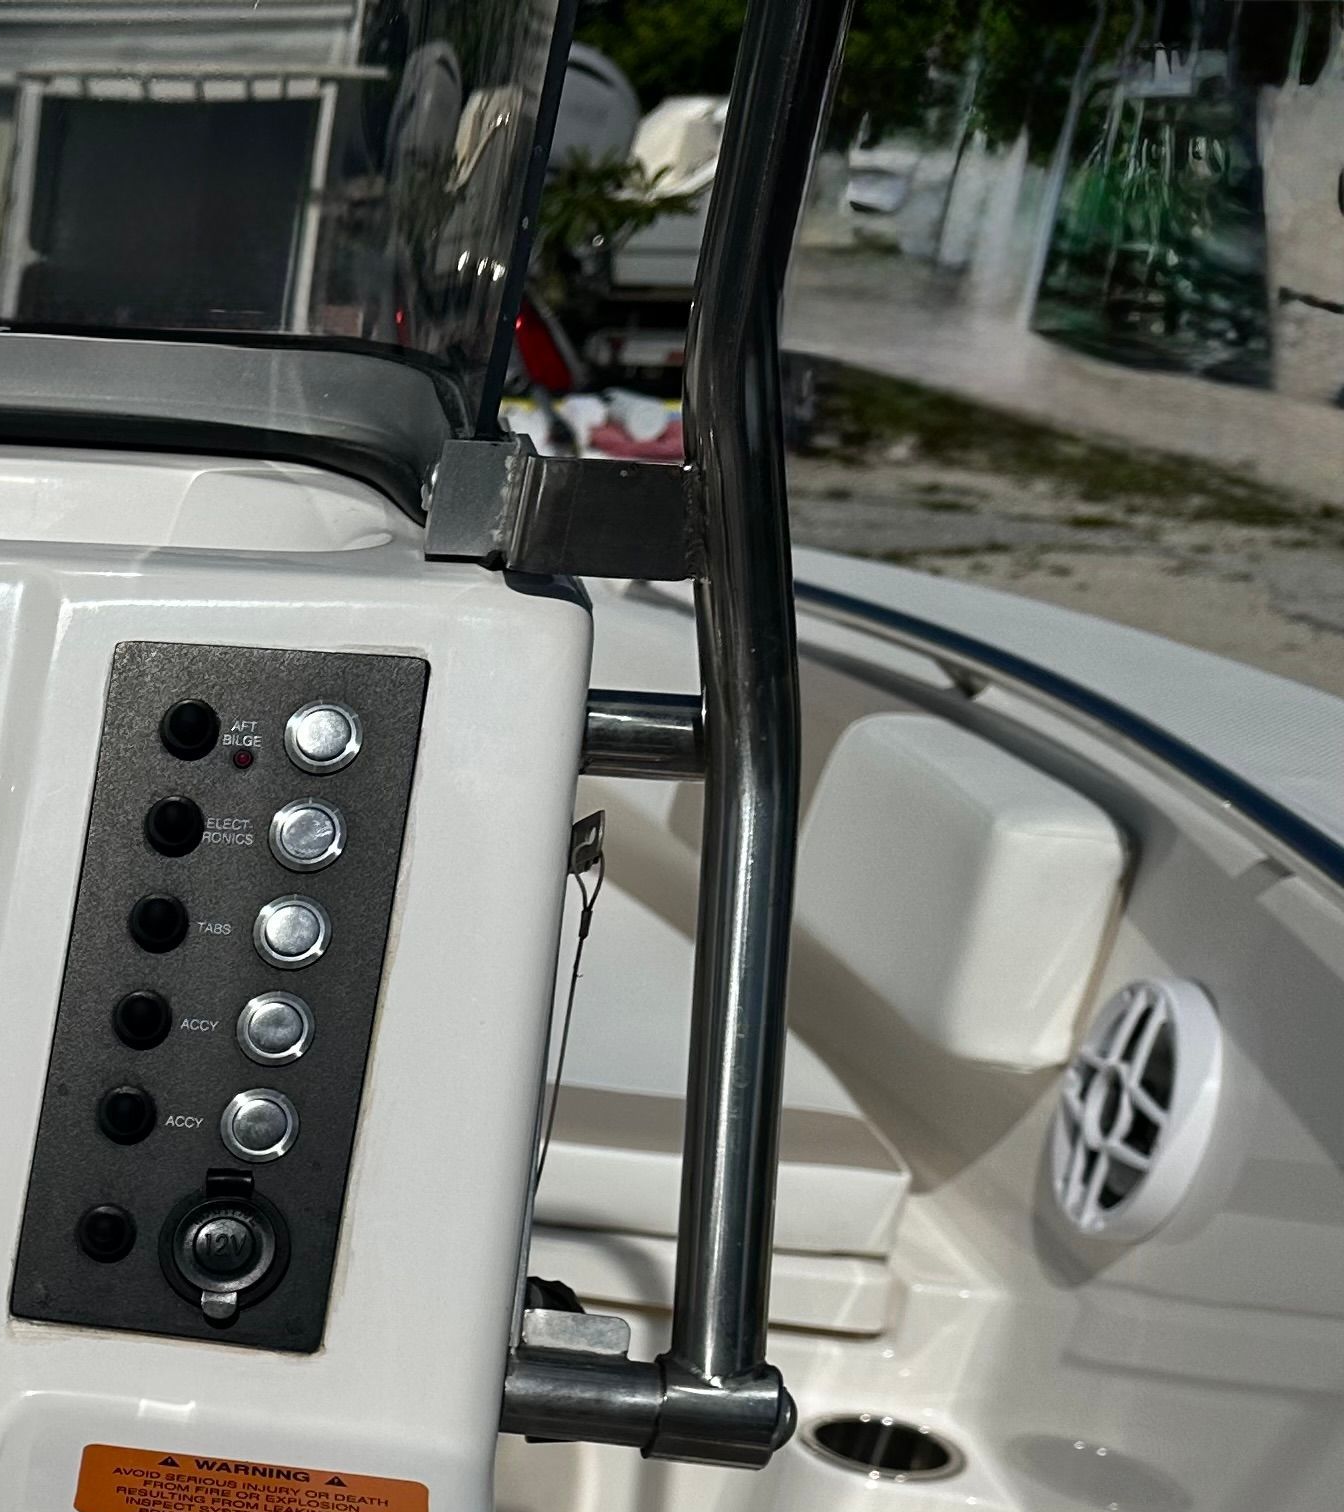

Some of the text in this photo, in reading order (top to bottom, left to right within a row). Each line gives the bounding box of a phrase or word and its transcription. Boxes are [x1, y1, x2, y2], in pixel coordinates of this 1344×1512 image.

[230, 720, 258, 732] AFT
[222, 733, 262, 748] BILGE
[197, 921, 232, 935] TABS
[180, 1018, 219, 1032] ACCY
[164, 1115, 204, 1129] ACCY
[193, 1458, 310, 1483] WARNING
[111, 1466, 388, 1507] AVOID SERIOUS INJURY OR DEATH
[142, 1479, 189, 1492] FROM
[195, 1486, 230, 1497] FIRE
[235, 1490, 260, 1501] OR
[115, 1485, 205, 1504] RESULTING
[210, 1497, 259, 1510] FROM
[125, 1496, 195, 1512] INSPECT
